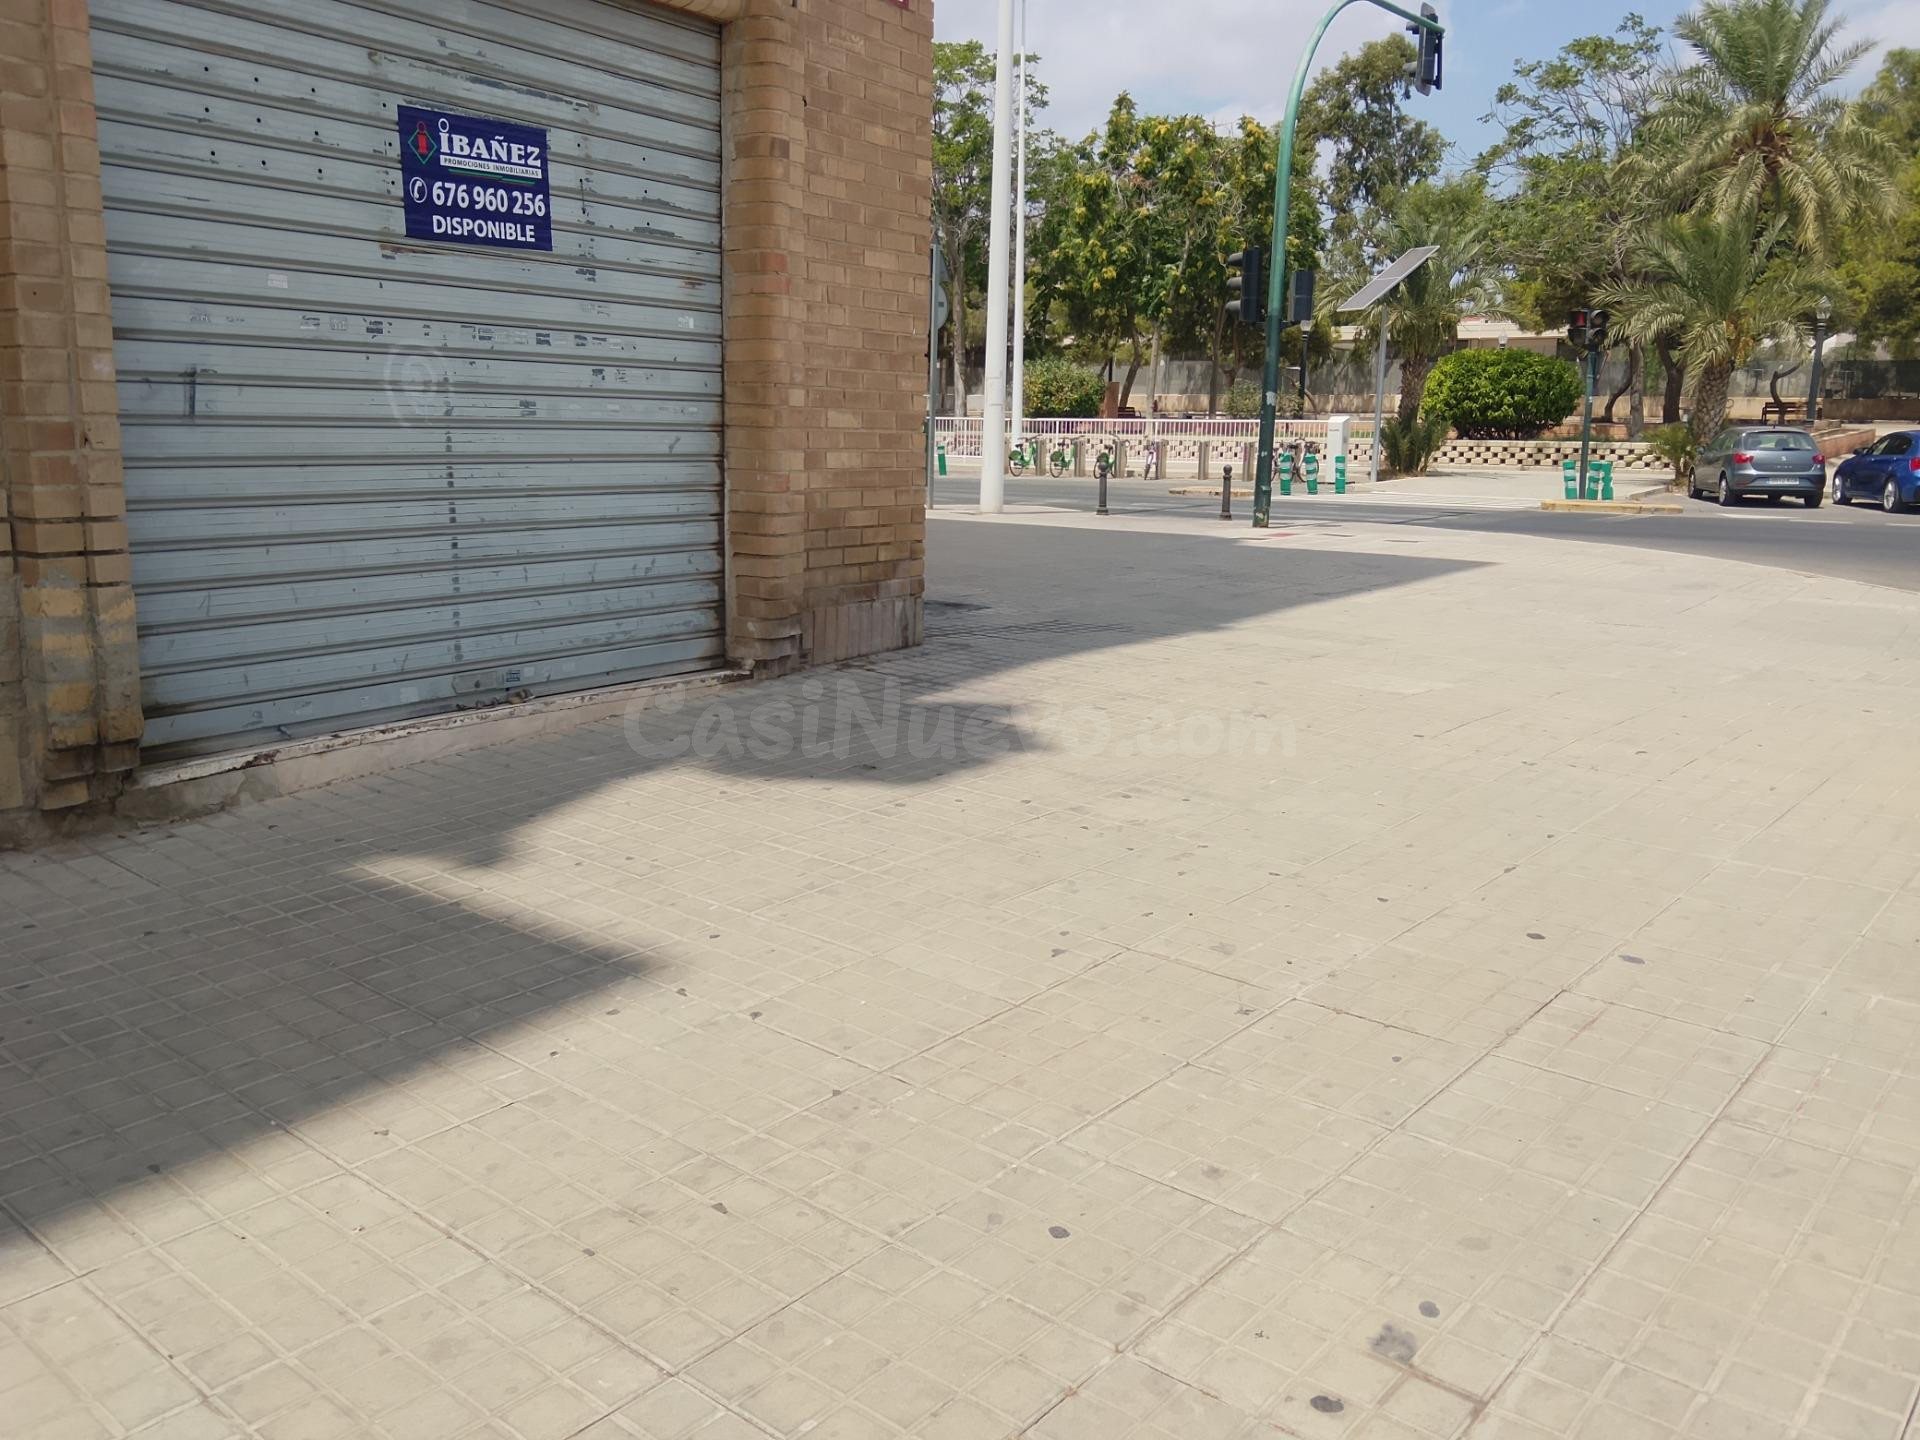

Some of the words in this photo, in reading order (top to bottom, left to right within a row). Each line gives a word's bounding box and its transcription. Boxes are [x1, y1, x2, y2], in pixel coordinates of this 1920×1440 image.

[443, 157, 491, 170] PROMOCIONES
[493, 164, 540, 178] INMOBILIARIAS
[432, 181, 469, 208] 676
[473, 185, 508, 212] 960
[512, 191, 546, 217] 256
[432, 215, 536, 242] DISPONIBLE
